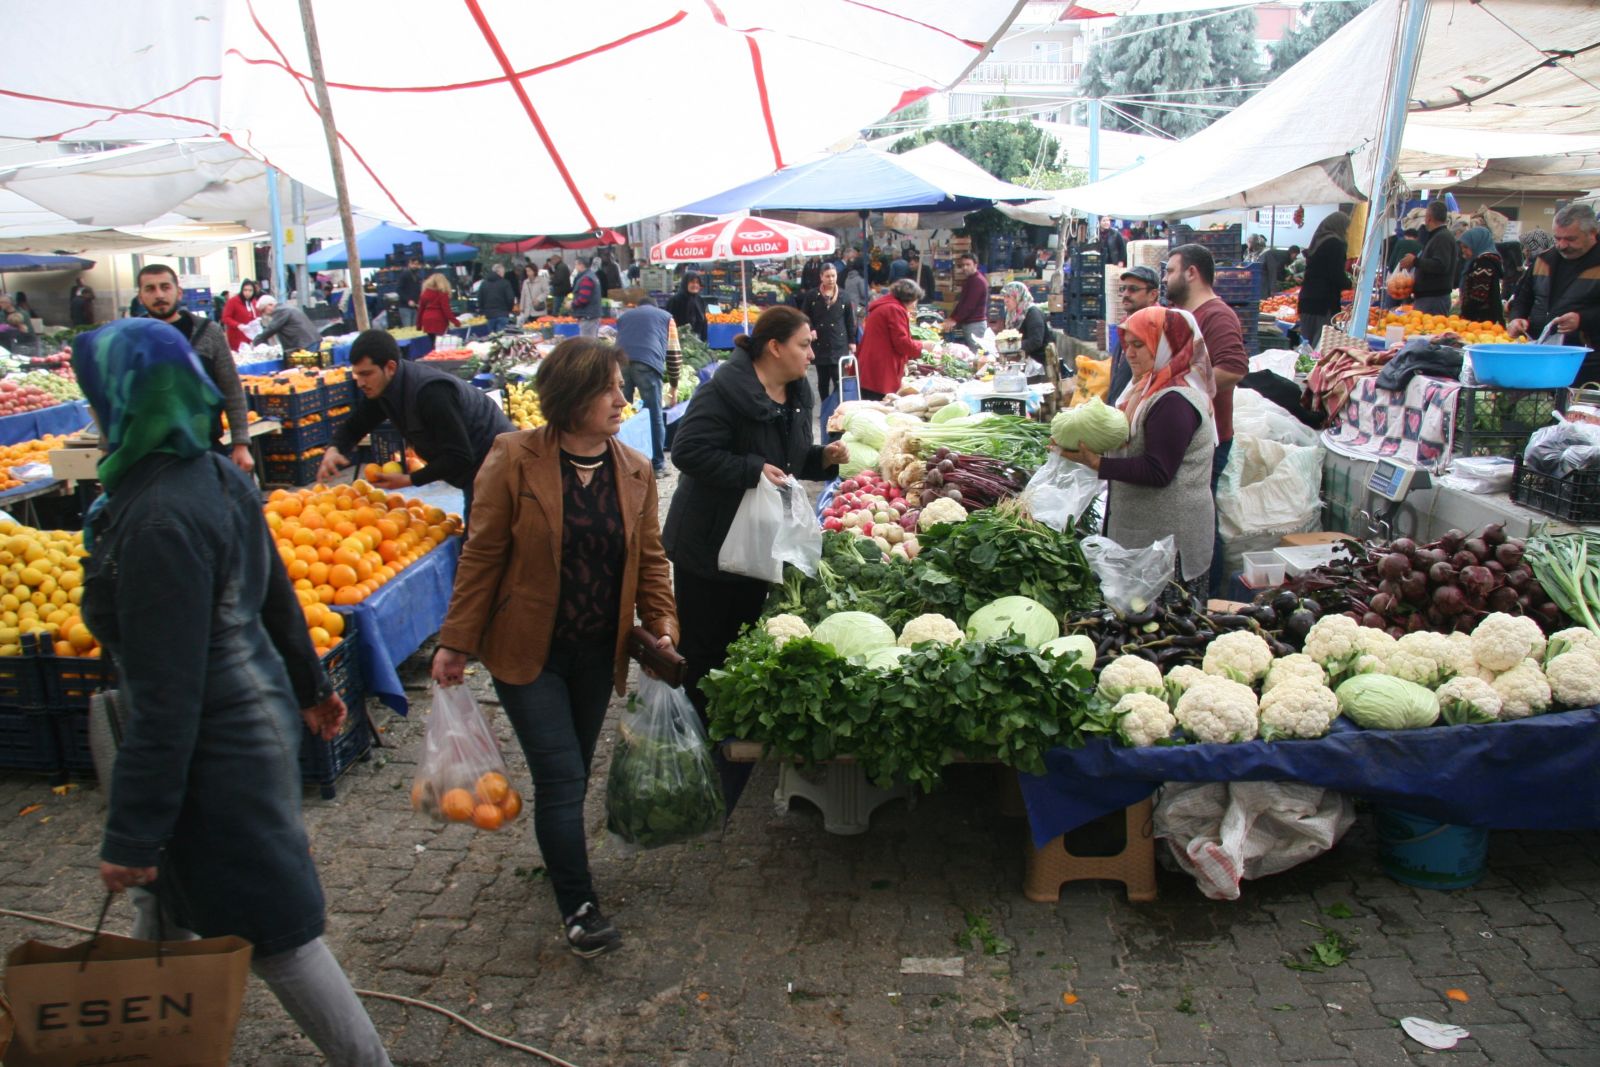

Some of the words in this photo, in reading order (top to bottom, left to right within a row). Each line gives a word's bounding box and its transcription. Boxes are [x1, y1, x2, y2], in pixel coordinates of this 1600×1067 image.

[673, 247, 704, 257] ALGIDA
[741, 242, 779, 253] ALGIDA
[36, 992, 193, 1031] ESEN
